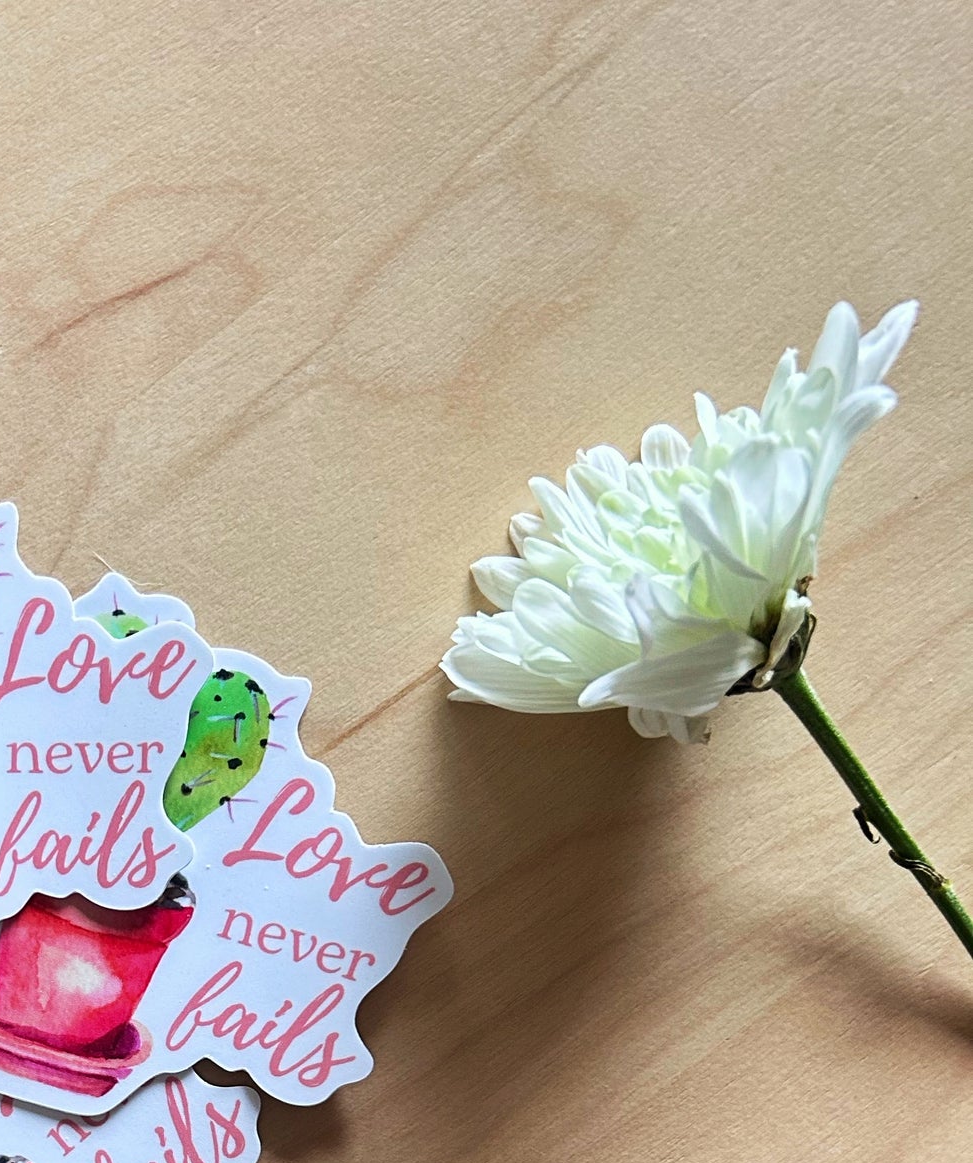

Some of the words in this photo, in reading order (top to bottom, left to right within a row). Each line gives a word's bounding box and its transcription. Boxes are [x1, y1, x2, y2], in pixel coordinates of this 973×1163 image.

[5, 736, 164, 774] never
[222, 778, 437, 917] Love
[217, 908, 376, 982] never
[165, 961, 356, 1087] fails
